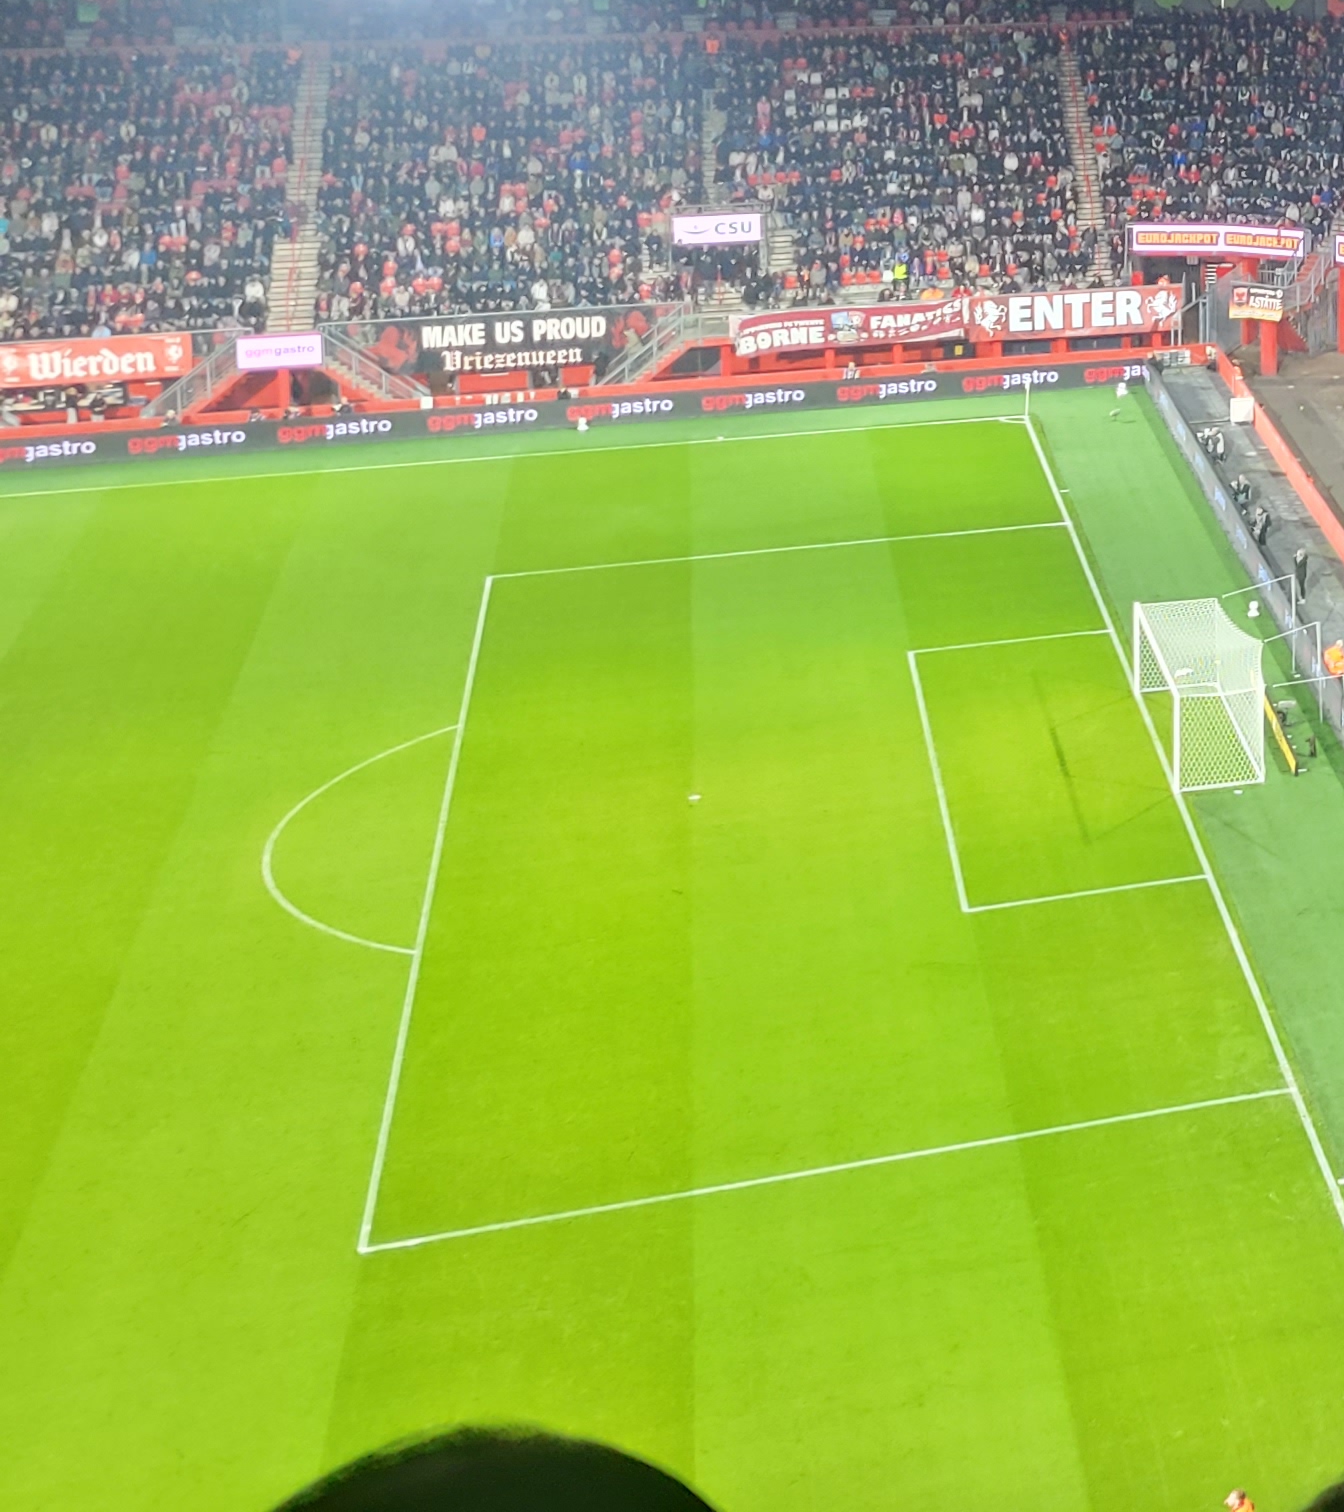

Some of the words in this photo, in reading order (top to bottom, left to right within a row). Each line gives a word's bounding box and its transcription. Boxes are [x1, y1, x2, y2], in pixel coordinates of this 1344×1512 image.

[714, 221, 752, 234] CSU
[1137, 232, 1219, 246] EUROJACKPOT
[1225, 233, 1300, 250] EUROJACKPOT
[738, 326, 825, 356] BORNE
[869, 298, 962, 330] FANATICS
[1008, 289, 1144, 333] ENTER
[421, 323, 485, 349] MAKE
[495, 320, 524, 344] US
[532, 316, 606, 341] PROUD
[27, 348, 156, 381] Wierden
